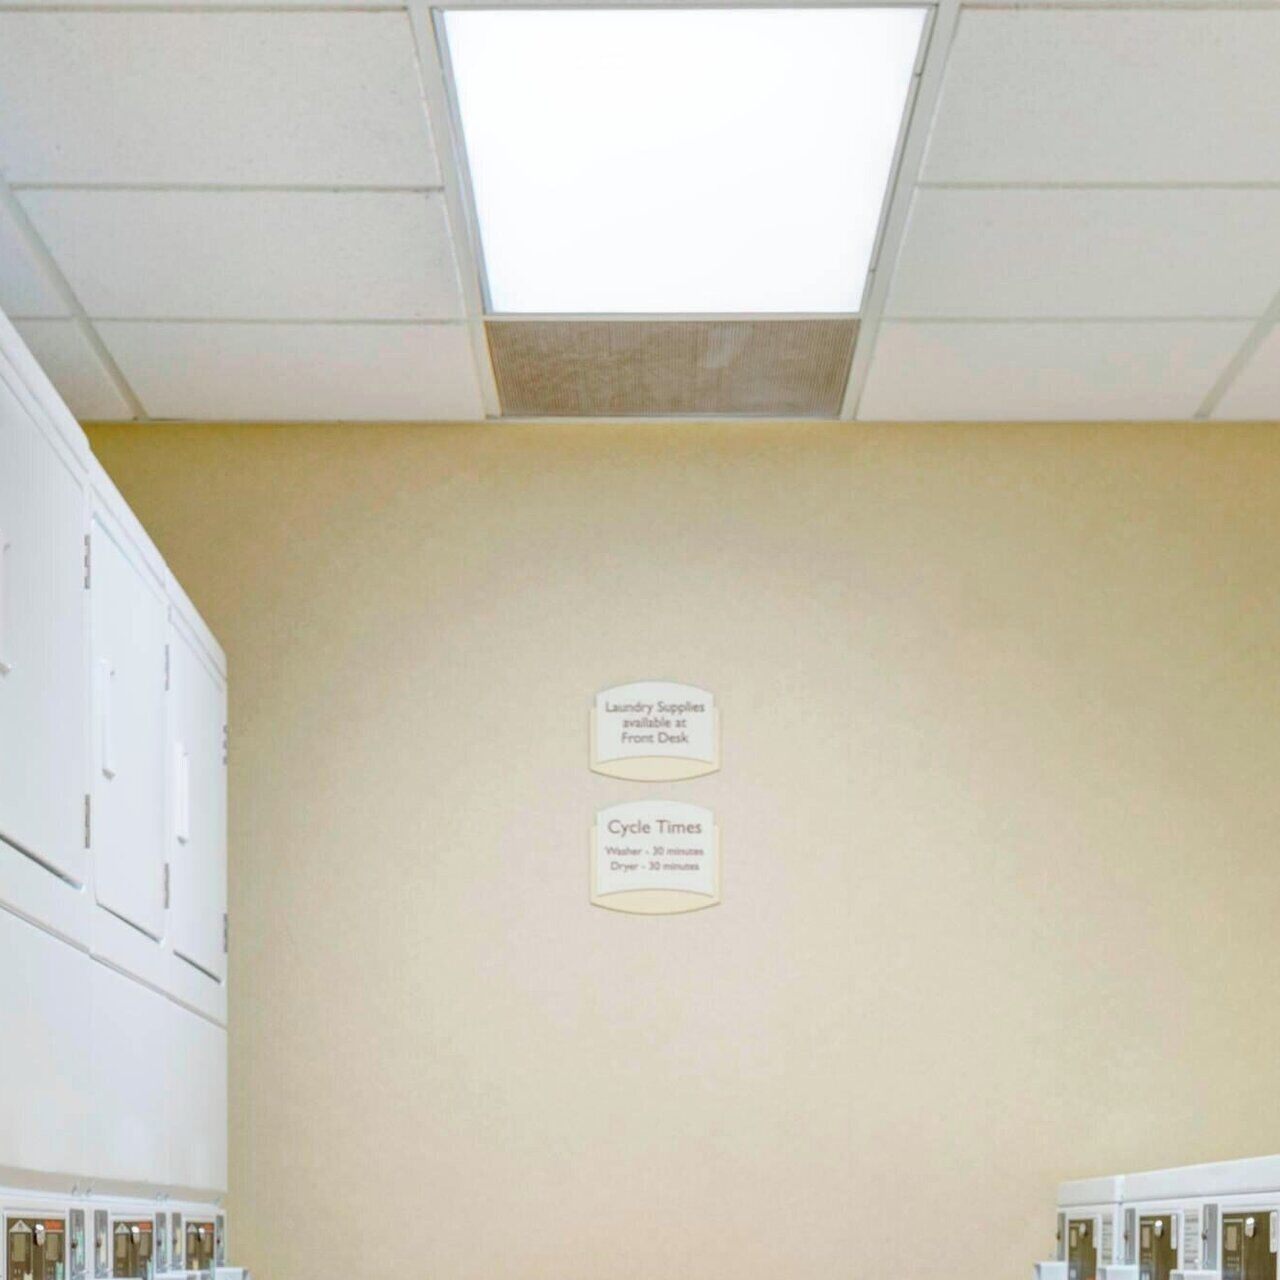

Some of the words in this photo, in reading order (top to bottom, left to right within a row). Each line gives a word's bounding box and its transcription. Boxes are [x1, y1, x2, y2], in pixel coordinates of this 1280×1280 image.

[605, 701, 654, 715] Laundry
[657, 700, 705, 715] Supplies
[623, 717, 671, 728] available
[675, 719, 687, 728] at
[621, 732, 654, 744] Front
[658, 732, 689, 743] Desk
[607, 819, 651, 837] Cycle
[656, 819, 702, 834] Times
[605, 846, 642, 856] Washer
[653, 846, 664, 856] 30
[666, 847, 704, 856] minutes
[610, 861, 639, 872] Dryer
[648, 861, 660, 870] 30
[663, 862, 700, 870] minutes
